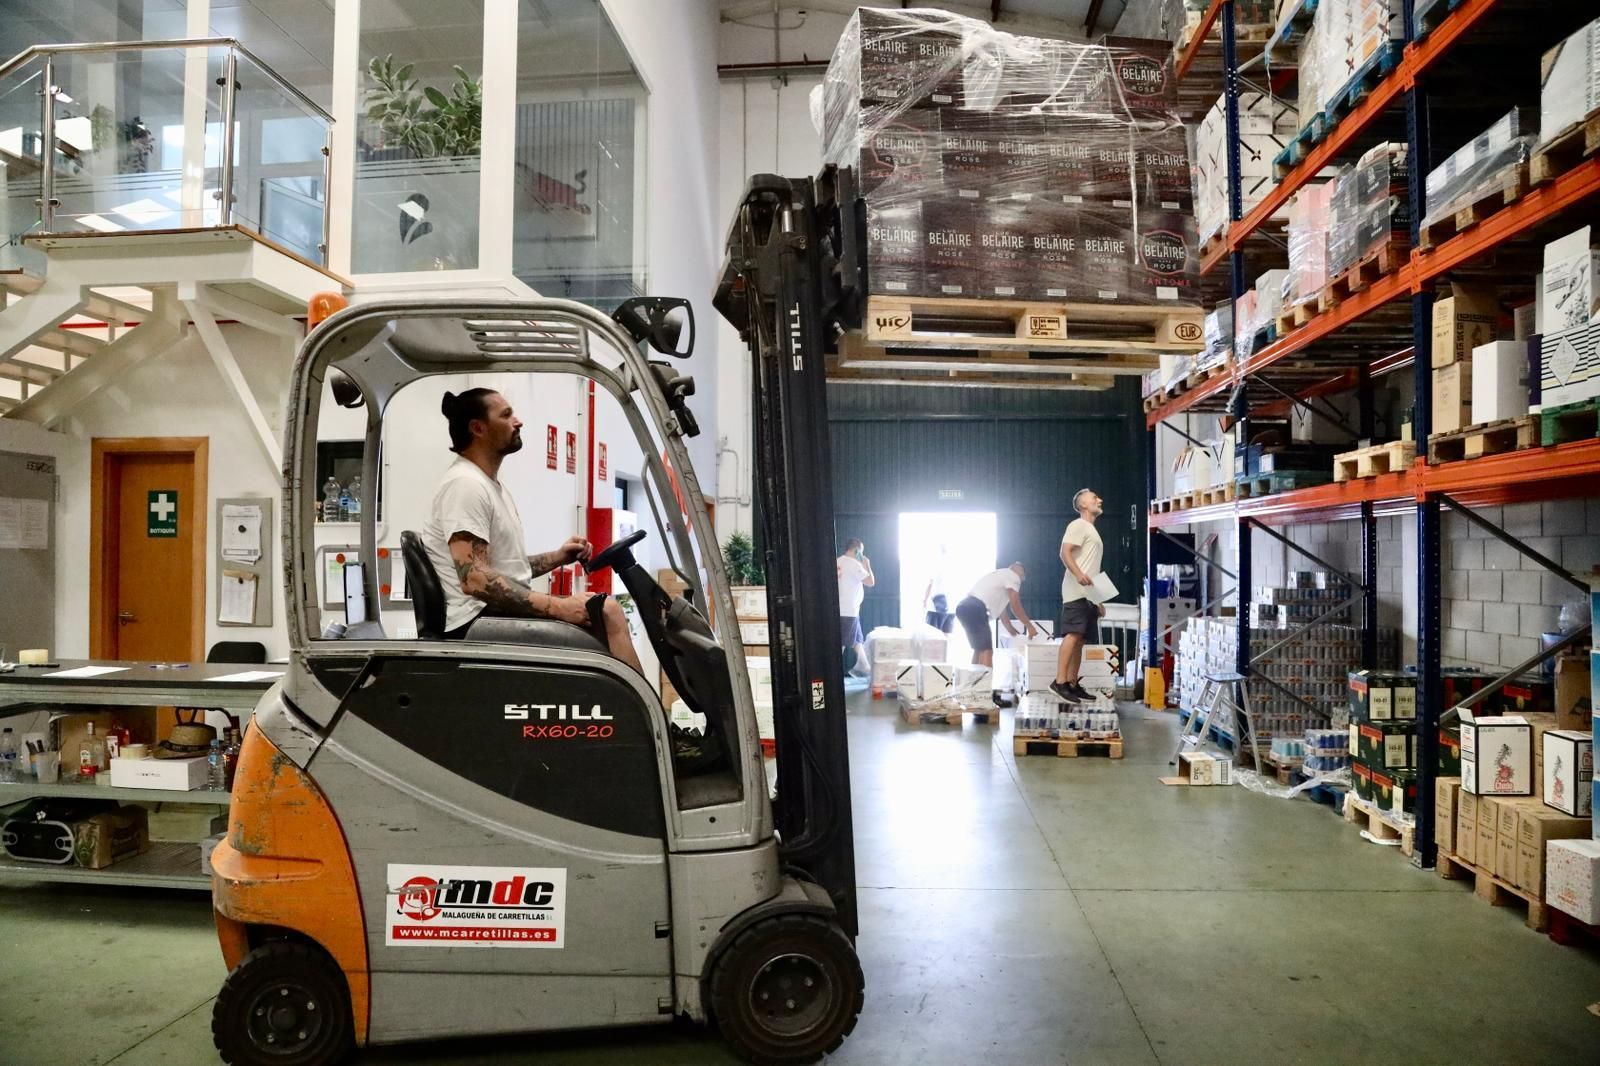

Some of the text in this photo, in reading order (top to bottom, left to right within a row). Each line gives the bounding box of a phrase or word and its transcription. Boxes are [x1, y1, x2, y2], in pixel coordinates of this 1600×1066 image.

[865, 39, 908, 54] BELAIRE
[1122, 67, 1162, 82] BELAIRE
[876, 138, 921, 153] BELAIRE
[946, 138, 988, 152] BELAIRE
[1000, 141, 1040, 155] BELAIRE
[1050, 144, 1090, 158] BELAIRE
[1100, 151, 1139, 163] BELAIRE
[1146, 154, 1185, 166] BELAIRE
[873, 228, 917, 243] BELAIRE
[929, 232, 972, 246] BELAIRE
[982, 234, 1025, 249] BELAIRE
[1034, 237, 1075, 251] BELAIRE
[1085, 239, 1125, 254] BELAIRE
[1144, 244, 1185, 259] BELAIRE
[789, 302, 803, 371] STILL
[1181, 326, 1196, 337] EUR
[504, 704, 613, 720] STILL
[523, 725, 614, 738] RX60-20
[442, 911, 486, 919] MALAGUEÑA
[498, 912, 545, 920] CARRETILLAS
[399, 928, 551, 940] www.mcarretillas.es
